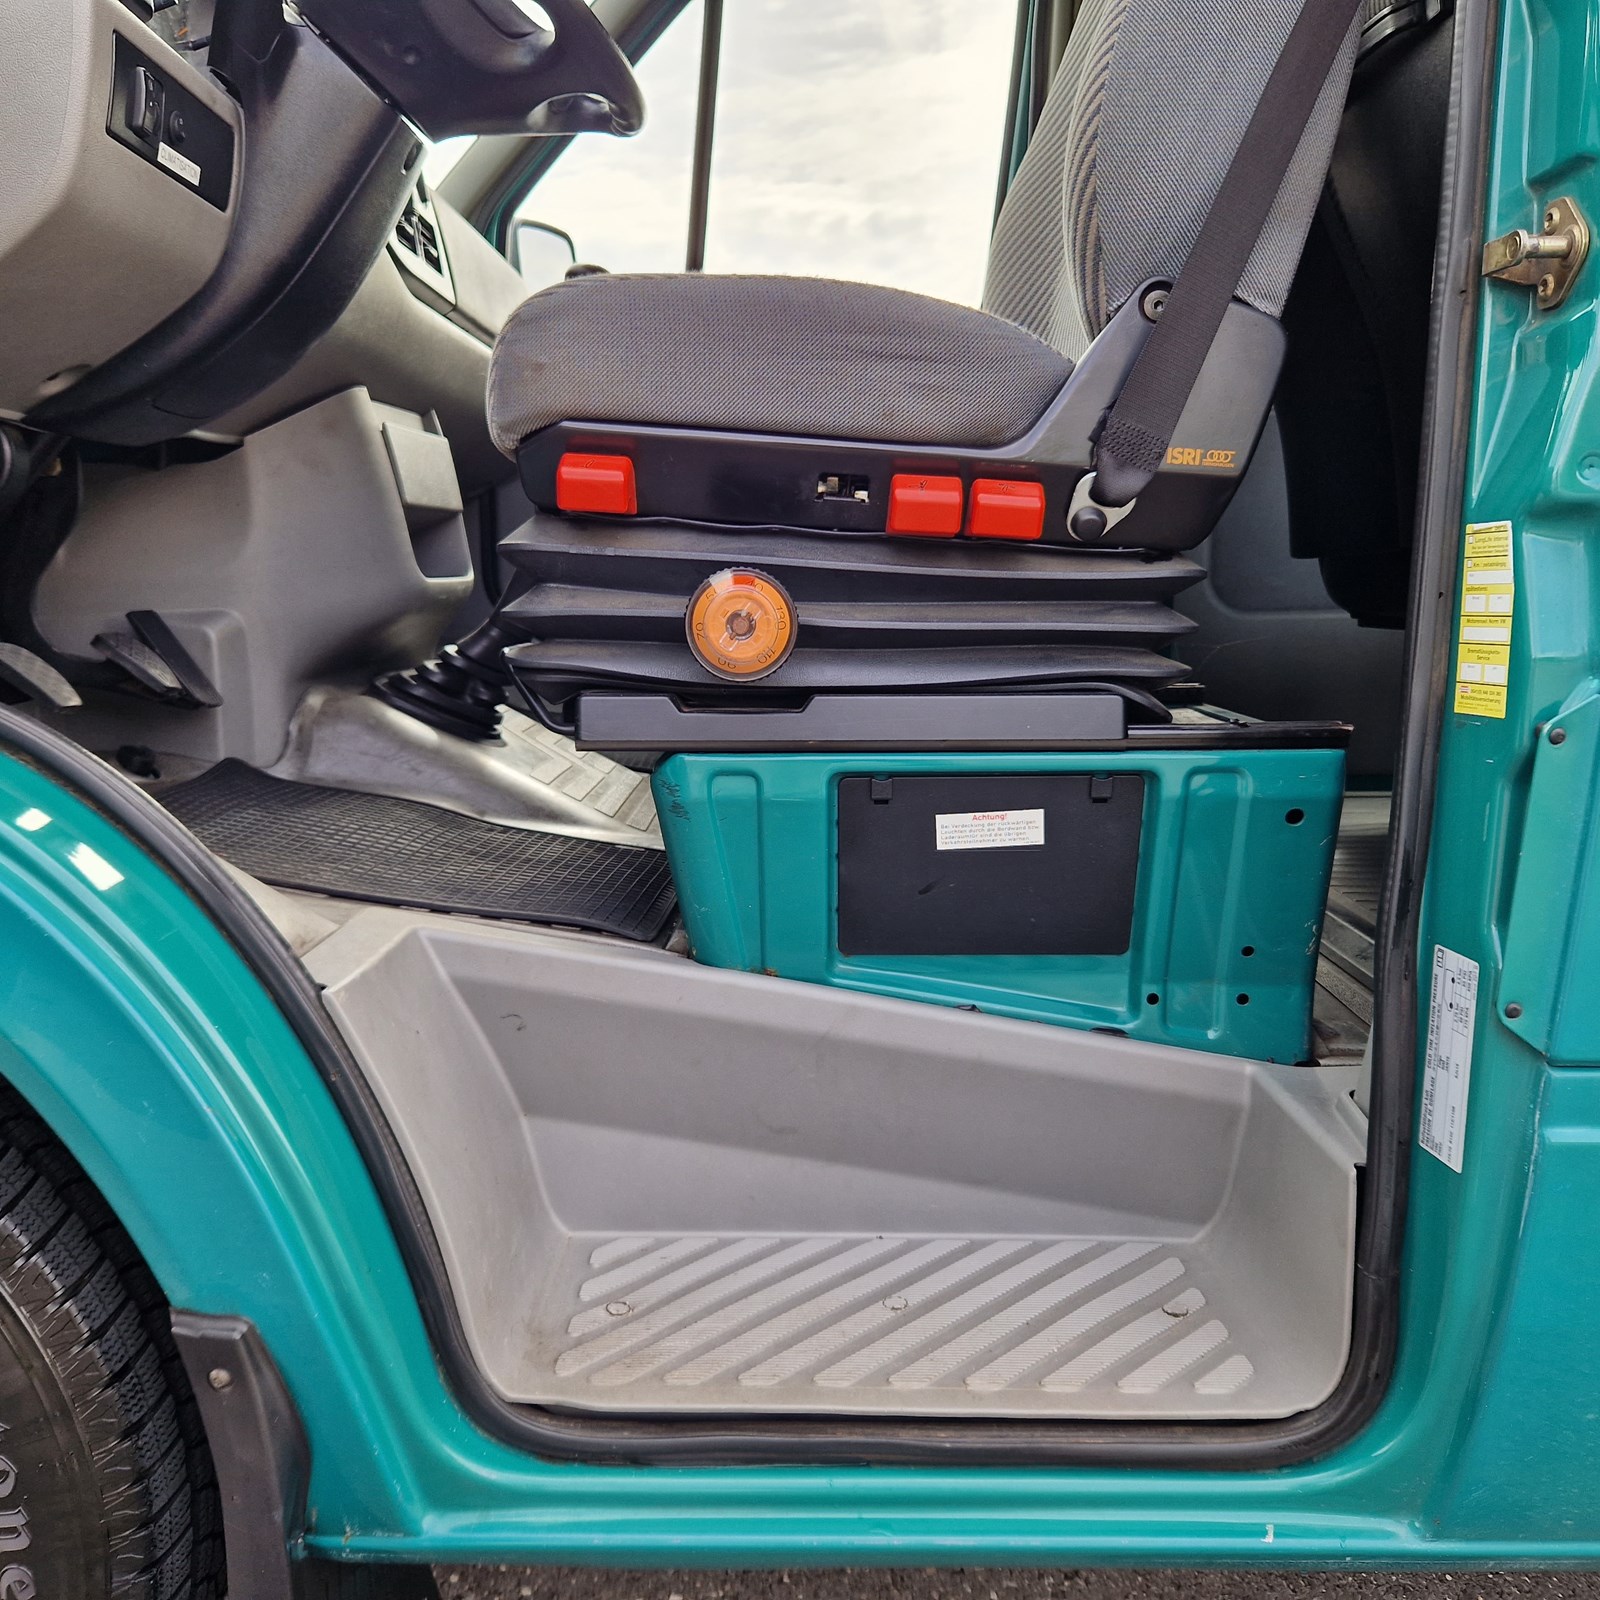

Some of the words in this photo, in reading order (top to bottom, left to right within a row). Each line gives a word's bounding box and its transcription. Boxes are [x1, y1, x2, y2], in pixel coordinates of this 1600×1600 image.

[1166, 447, 1201, 465] ISRI
[748, 580, 764, 592] 40
[972, 813, 1008, 821] Achtung!
